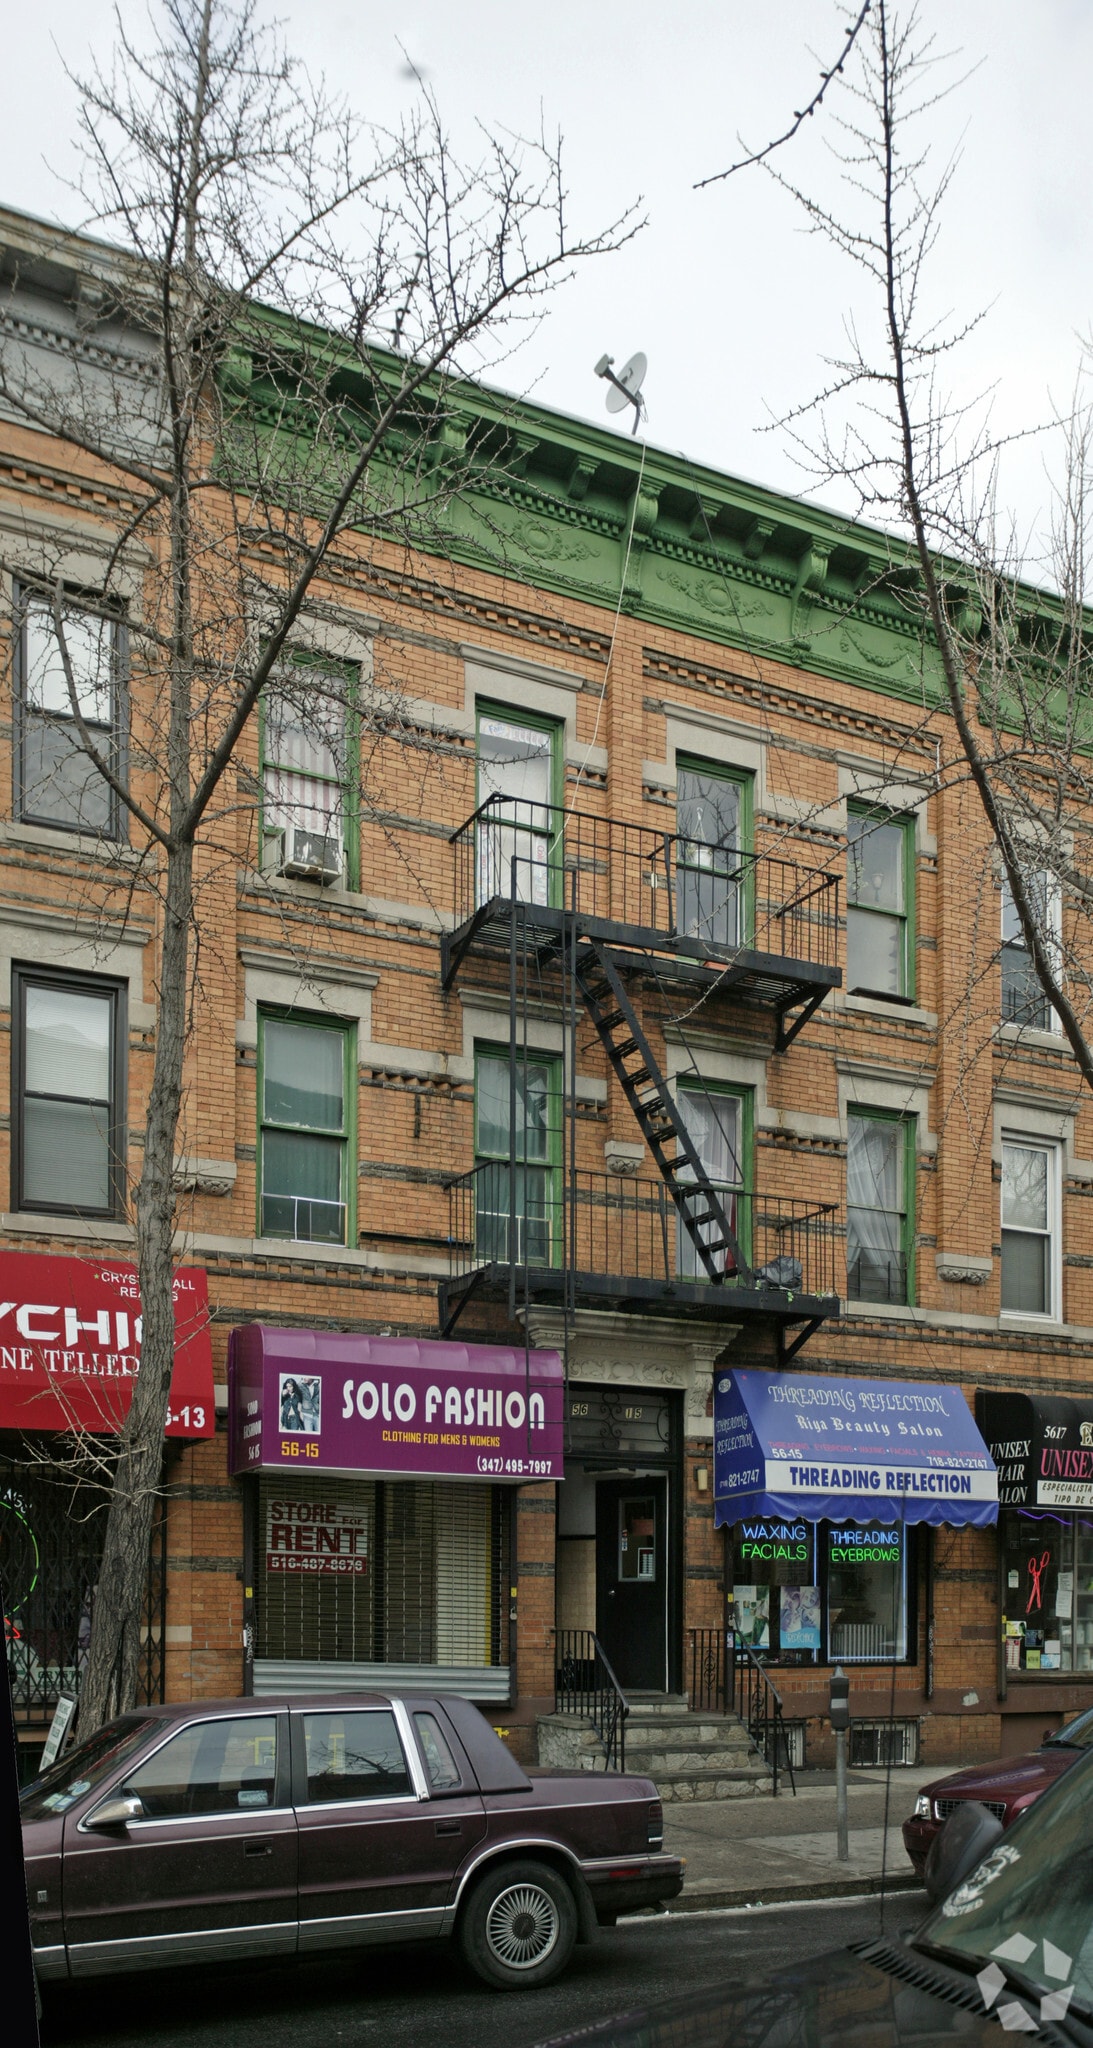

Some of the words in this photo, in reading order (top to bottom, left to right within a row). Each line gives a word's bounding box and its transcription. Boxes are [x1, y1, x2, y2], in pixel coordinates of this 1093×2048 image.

[342, 1379, 417, 1422] SOLO
[425, 1384, 545, 1430] FASHION
[572, 1404, 588, 1415] 56
[768, 1386, 855, 1412] THREADING
[859, 1392, 950, 1416] REFLECTION
[795, 1414, 828, 1432] Riya
[830, 1416, 890, 1436] Beauty
[898, 1422, 943, 1436] Salon
[1044, 1425, 1067, 1439] 5617
[382, 1429, 421, 1443] CLOTHING
[423, 1432, 439, 1444] FOR
[440, 1433, 461, 1446] MENS
[462, 1434, 467, 1445] &
[469, 1435, 501, 1447] WOMENS
[281, 1441, 319, 1457] 56-15
[772, 1448, 803, 1459] 56-15
[990, 1439, 1031, 1459] UNISEX
[477, 1455, 504, 1472] (347)
[505, 1458, 552, 1474] 495-7997
[926, 1456, 988, 1469] 718-821-2747
[728, 1469, 760, 1488] 821-2747
[790, 1467, 880, 1489] THREADING
[886, 1472, 971, 1493] REFLECTION
[999, 1486, 1028, 1504] ALON
[1042, 1483, 1092, 1493] ESPECIALISTA
[1054, 1494, 1071, 1503] TIPO
[1076, 1495, 1085, 1504] DE
[271, 1502, 337, 1524] STORE
[271, 1523, 364, 1554] RENT
[742, 1524, 807, 1541] WAXING
[830, 1531, 899, 1545] THREADING
[741, 1543, 807, 1560] FACIALS
[831, 1548, 900, 1562] EYEBROWS
